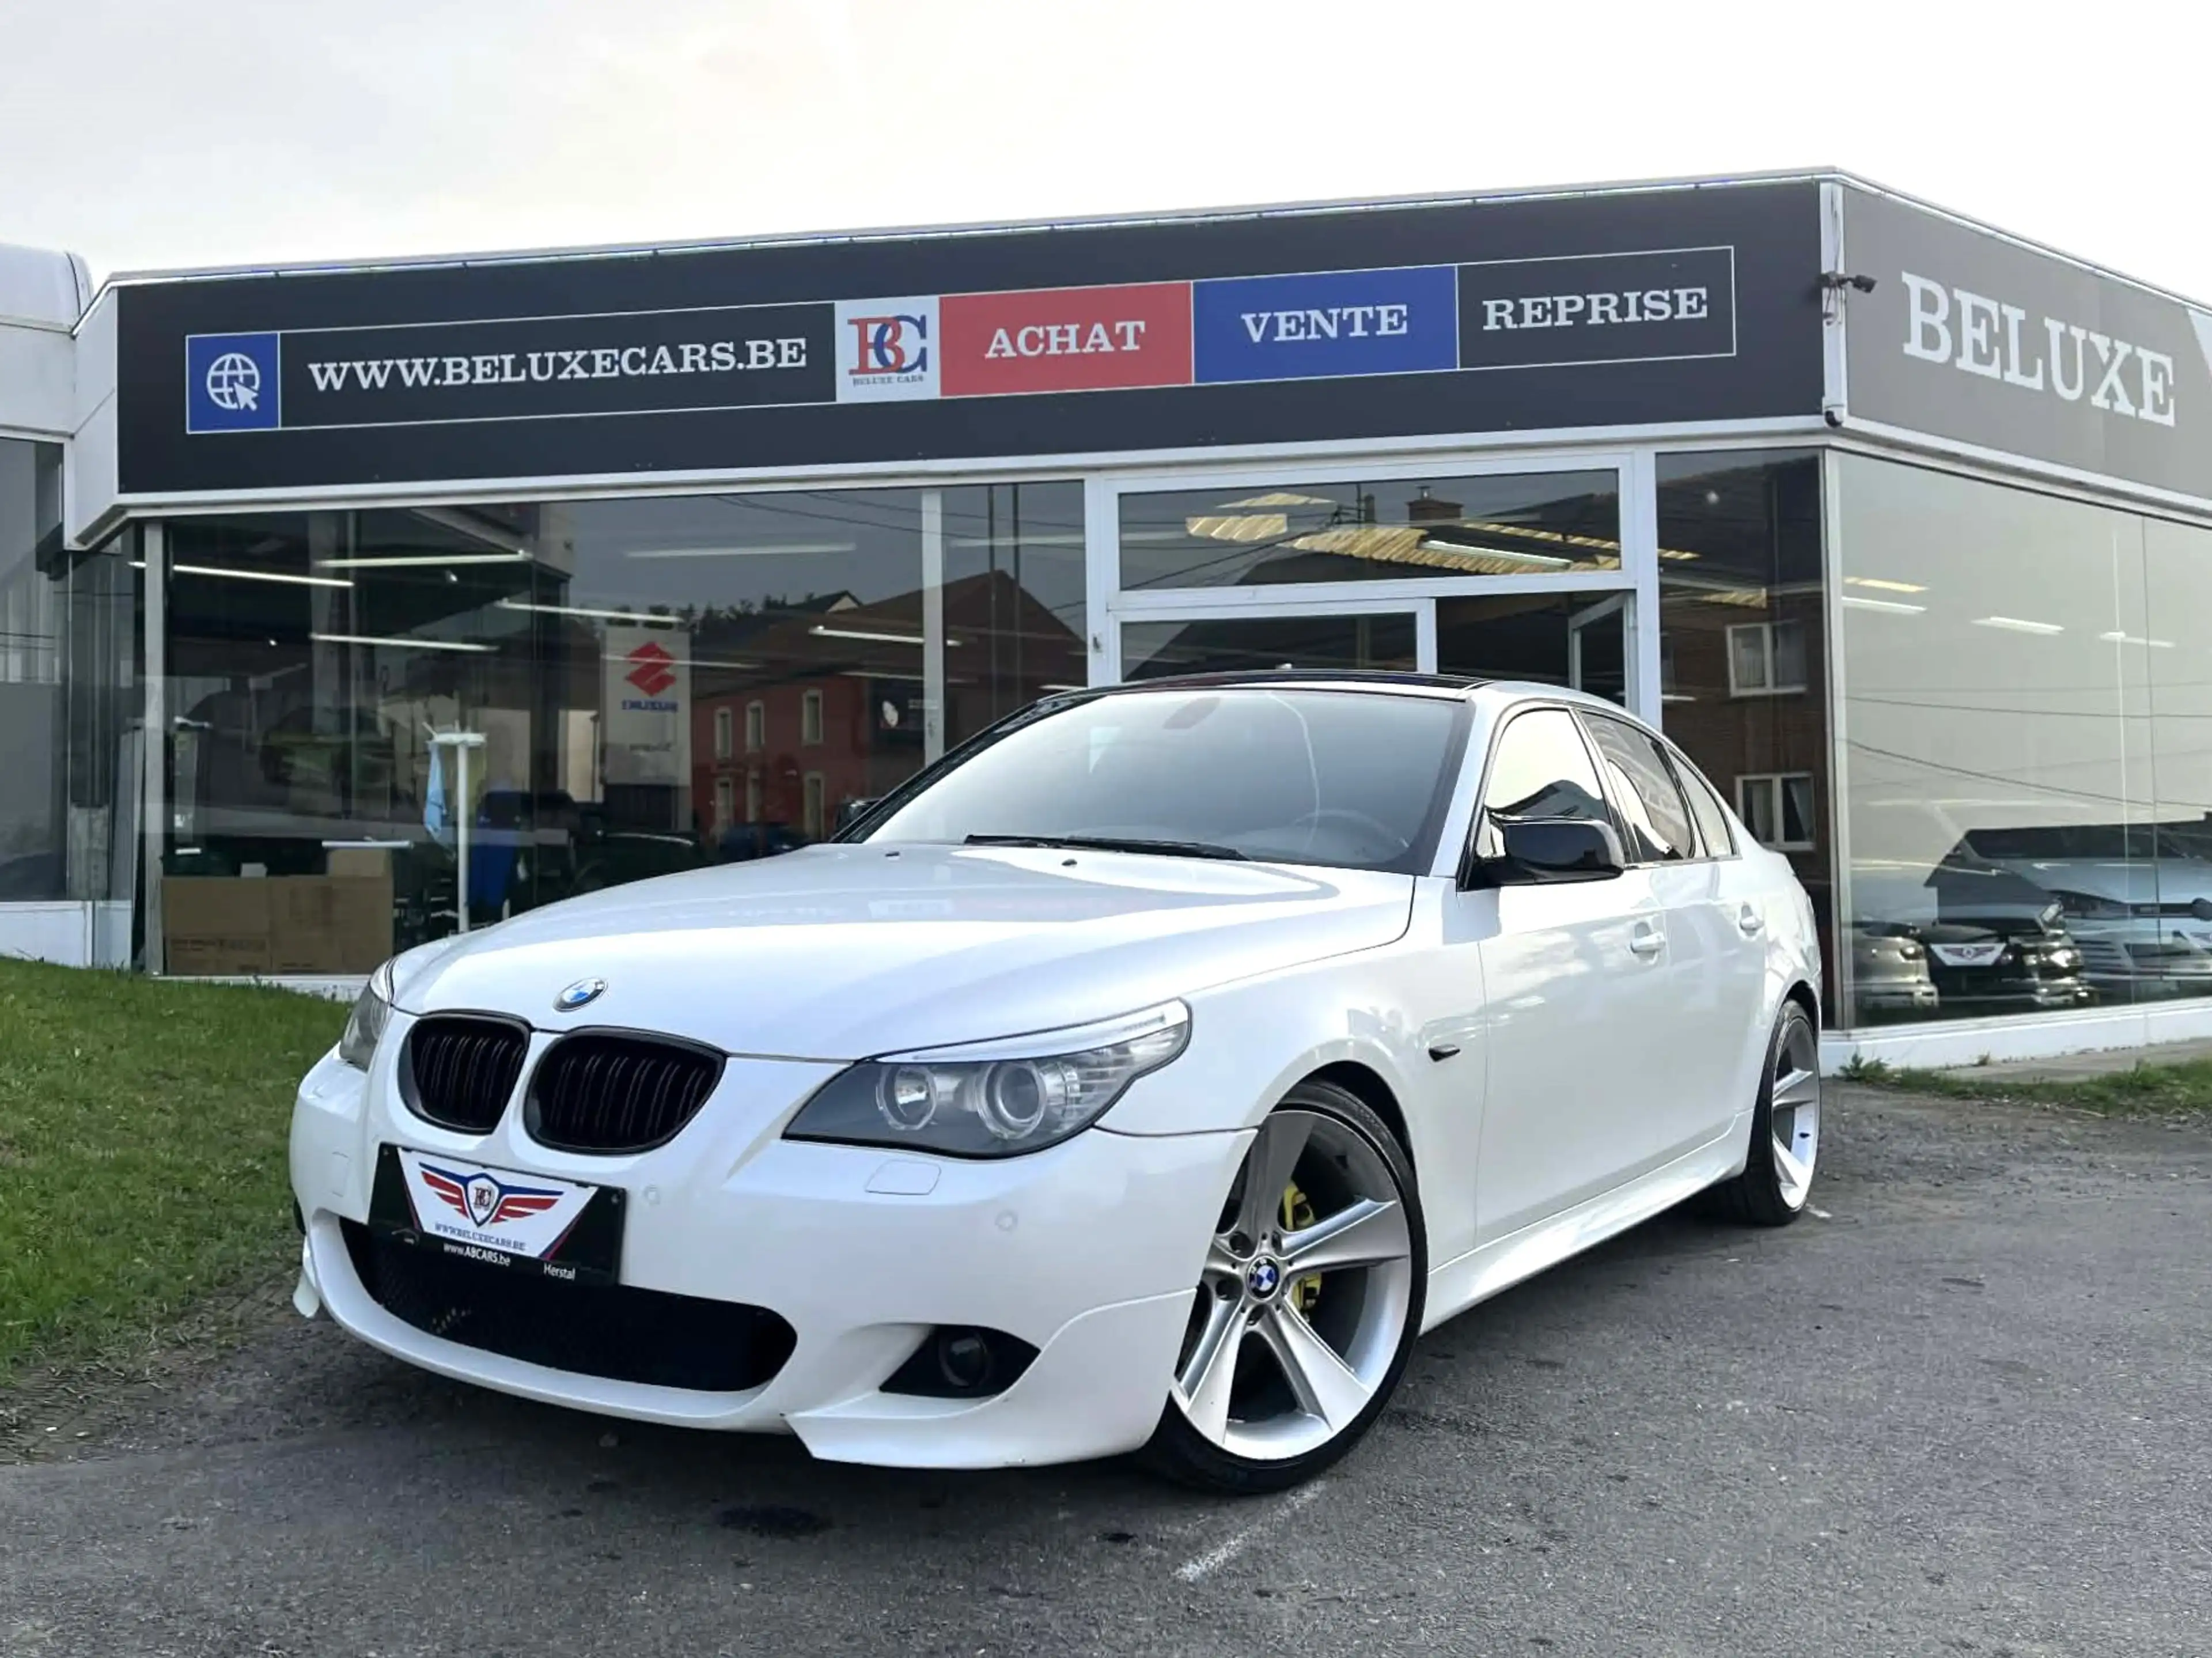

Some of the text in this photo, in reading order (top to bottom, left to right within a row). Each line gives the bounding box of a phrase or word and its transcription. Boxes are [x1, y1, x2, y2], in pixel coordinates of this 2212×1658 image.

[1241, 304, 1407, 343] VENTE
[1482, 287, 1708, 331] REPRISE
[984, 321, 1146, 358] ACHAT
[1902, 270, 2175, 427] BELUXE
[308, 338, 806, 391] WWW.BELUXECARS.BE
[443, 1242, 511, 1267] www.ABCARS.be
[543, 1262, 575, 1281] Herstal
